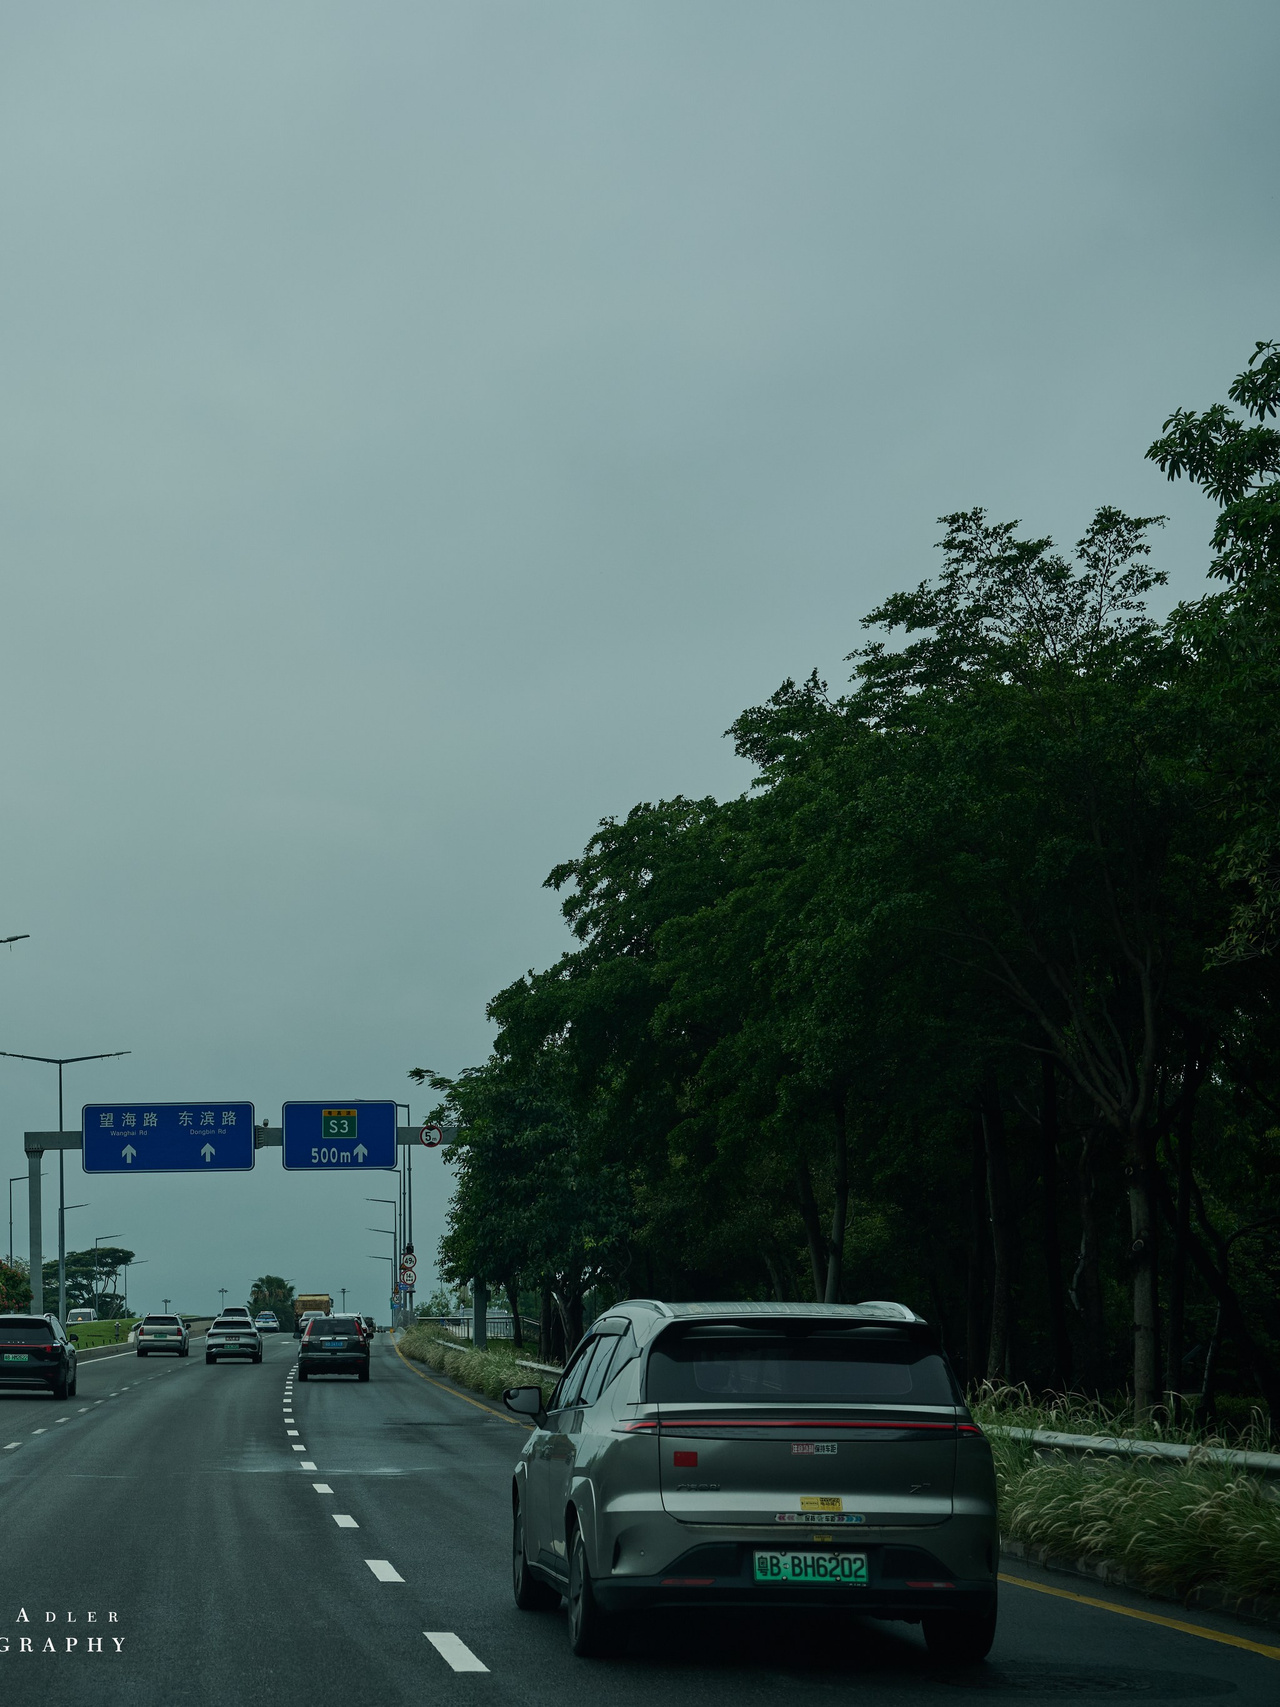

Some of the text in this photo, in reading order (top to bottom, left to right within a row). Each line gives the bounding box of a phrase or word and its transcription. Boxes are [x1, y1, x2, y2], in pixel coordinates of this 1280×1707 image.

[99, 1111, 158, 1128] 望海路
[178, 1110, 237, 1126] 东滨路
[329, 1119, 349, 1133] S3
[190, 1128, 215, 1136] Dongbin
[311, 1147, 351, 1163] 500m
